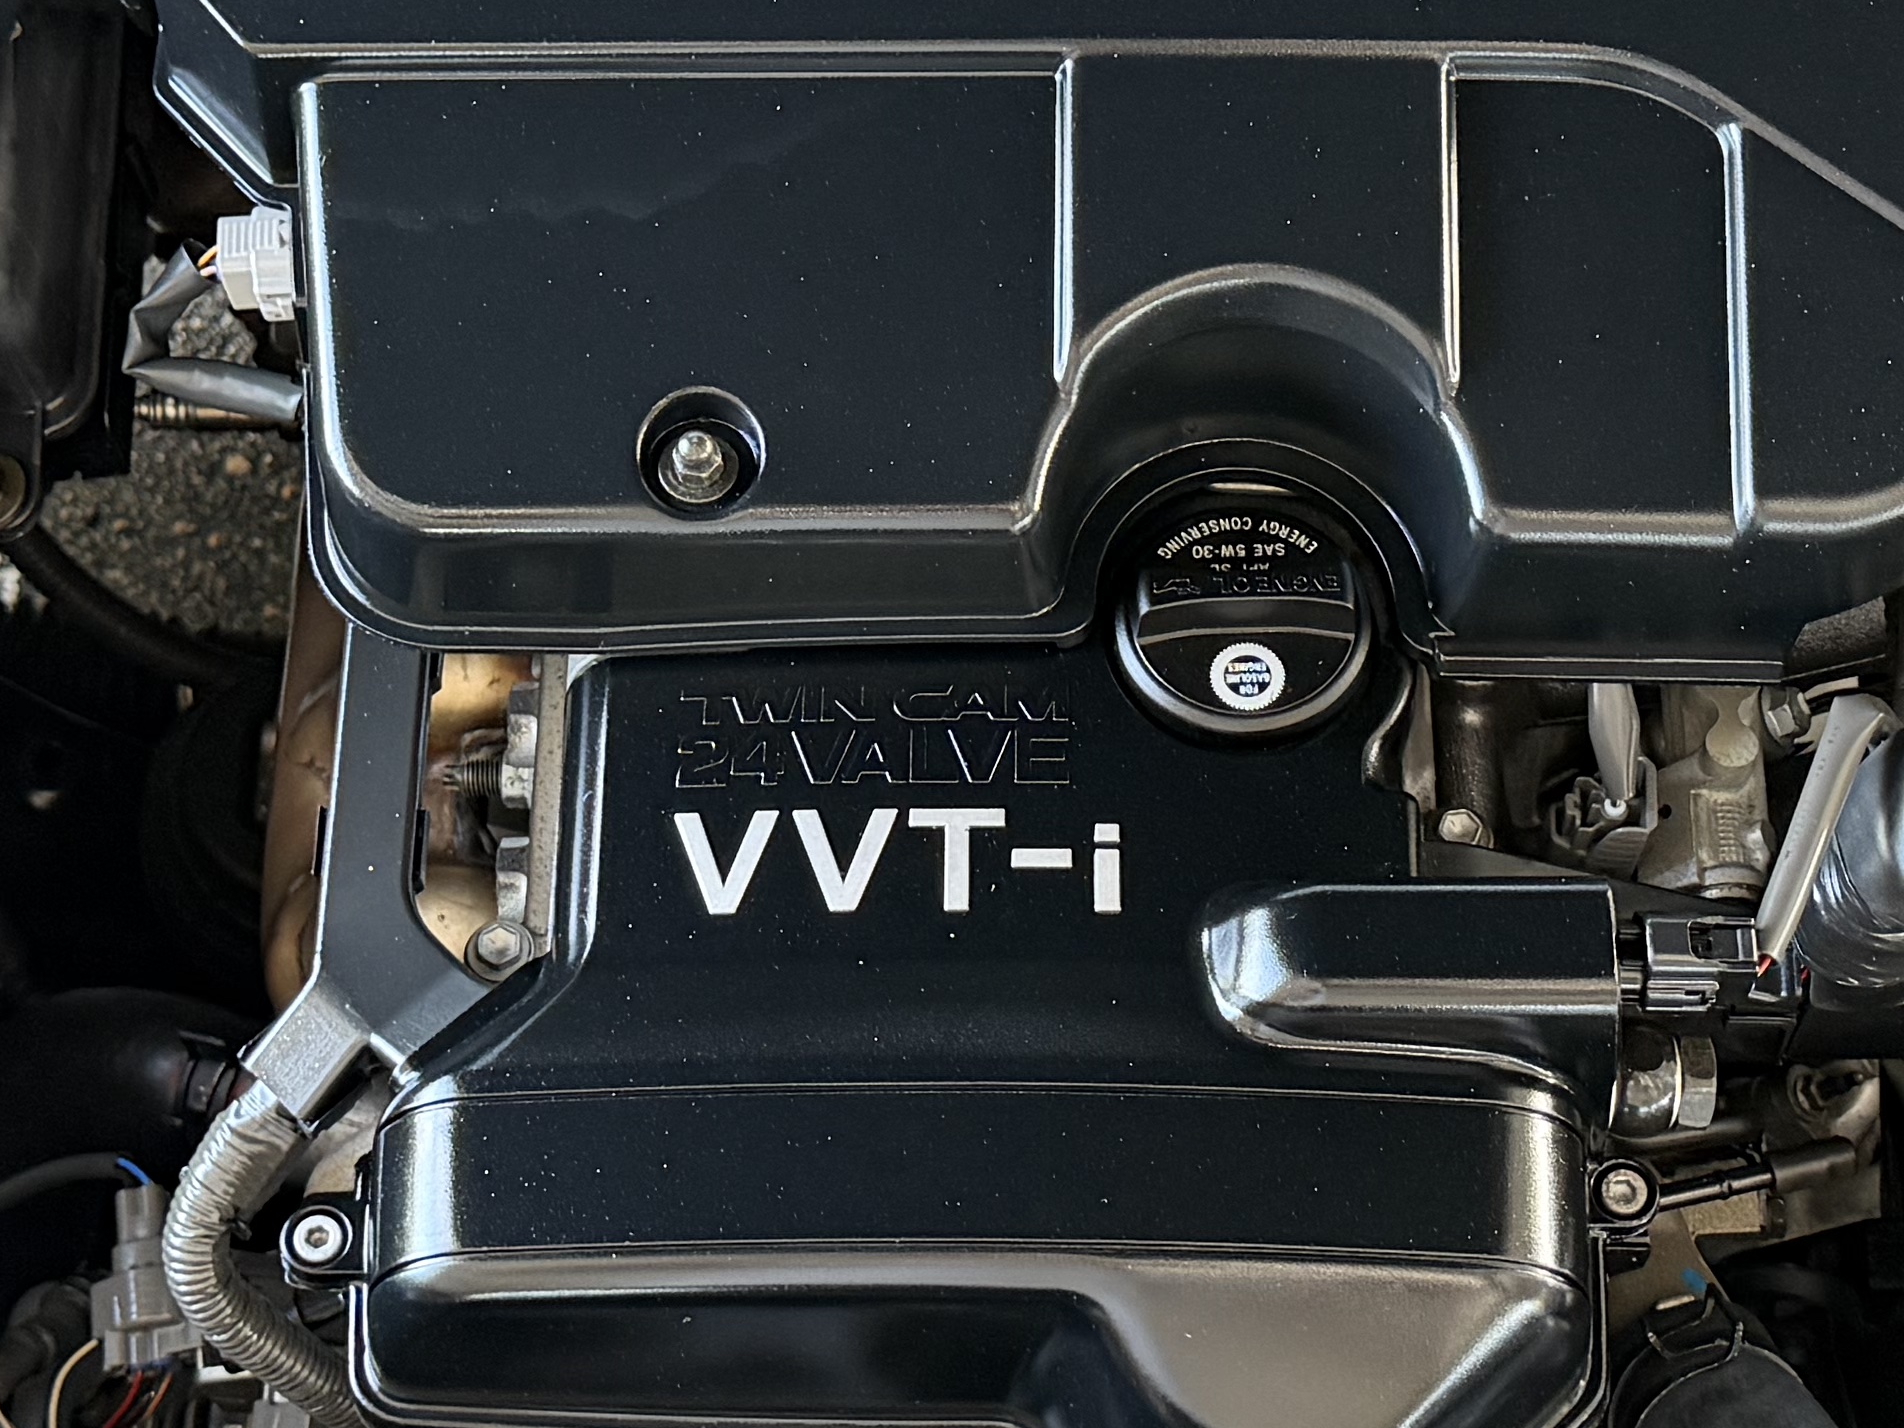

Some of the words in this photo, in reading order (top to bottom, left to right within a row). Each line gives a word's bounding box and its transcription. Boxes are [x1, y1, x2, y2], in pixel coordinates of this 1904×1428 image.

[1157, 516, 1252, 560] CONSERVING
[1253, 543, 1286, 556] SAE
[1258, 518, 1318, 554] ENERGY
[1192, 544, 1246, 558] 5W-30
[1213, 576, 1250, 593] OIL
[1256, 575, 1341, 593] ENGINE
[677, 682, 876, 727] TWIN
[893, 682, 1080, 727] CAM
[673, 806, 1123, 915] VVT-i
